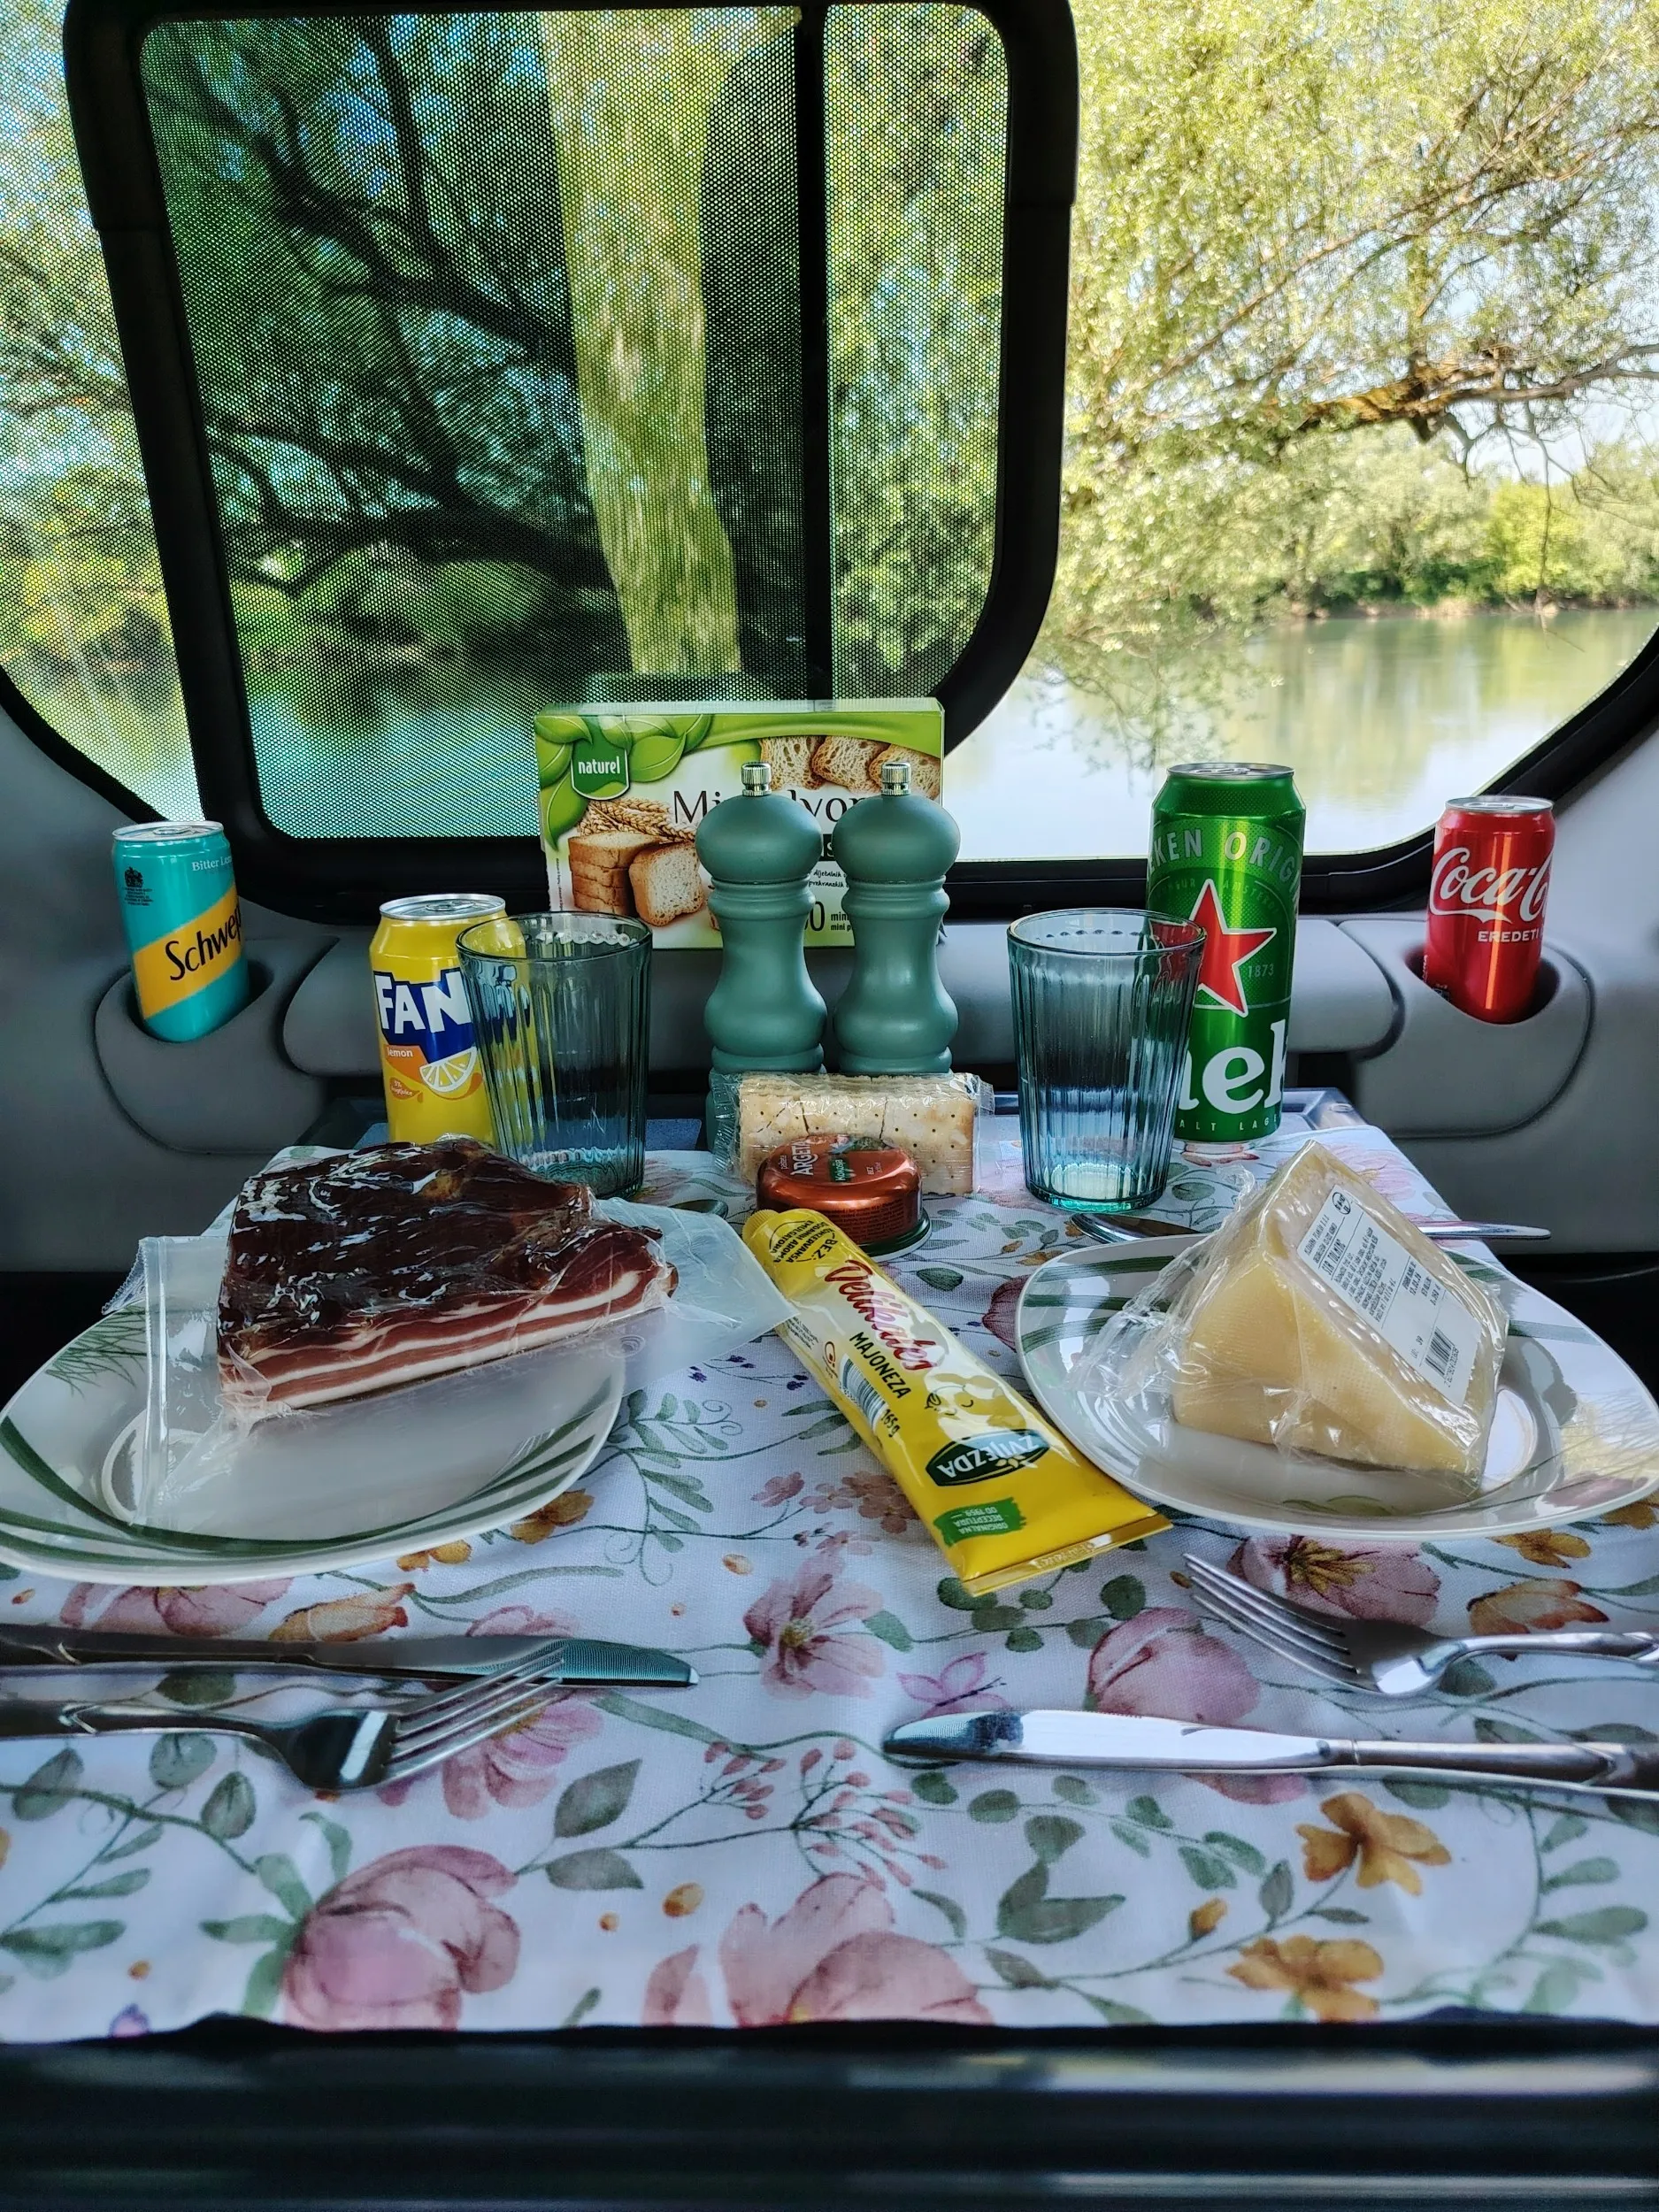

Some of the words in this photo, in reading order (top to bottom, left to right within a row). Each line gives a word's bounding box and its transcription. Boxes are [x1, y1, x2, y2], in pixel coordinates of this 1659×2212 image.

[578, 756, 621, 774] naturel
[1150, 828, 1203, 873] KEN
[191, 859, 219, 872] Bitter
[1477, 928, 1540, 943] EREDETI
[1248, 964, 1274, 979] 1873
[374, 971, 472, 1034] FAN
[387, 1046, 414, 1058] lemon
[1179, 1118, 1217, 1132] ALT
[789, 1138, 819, 1177] ARGETA
[811, 1238, 839, 1261] BEZ:
[824, 1259, 938, 1371] Delikates
[849, 1331, 912, 1399] MAJONEZA
[880, 1409, 901, 1438] 165g
[936, 1434, 1040, 1479] ZVIJEZDA
[953, 1514, 1004, 1527] RECEPTURA
[957, 1521, 1009, 1534] ORIGINALNA
